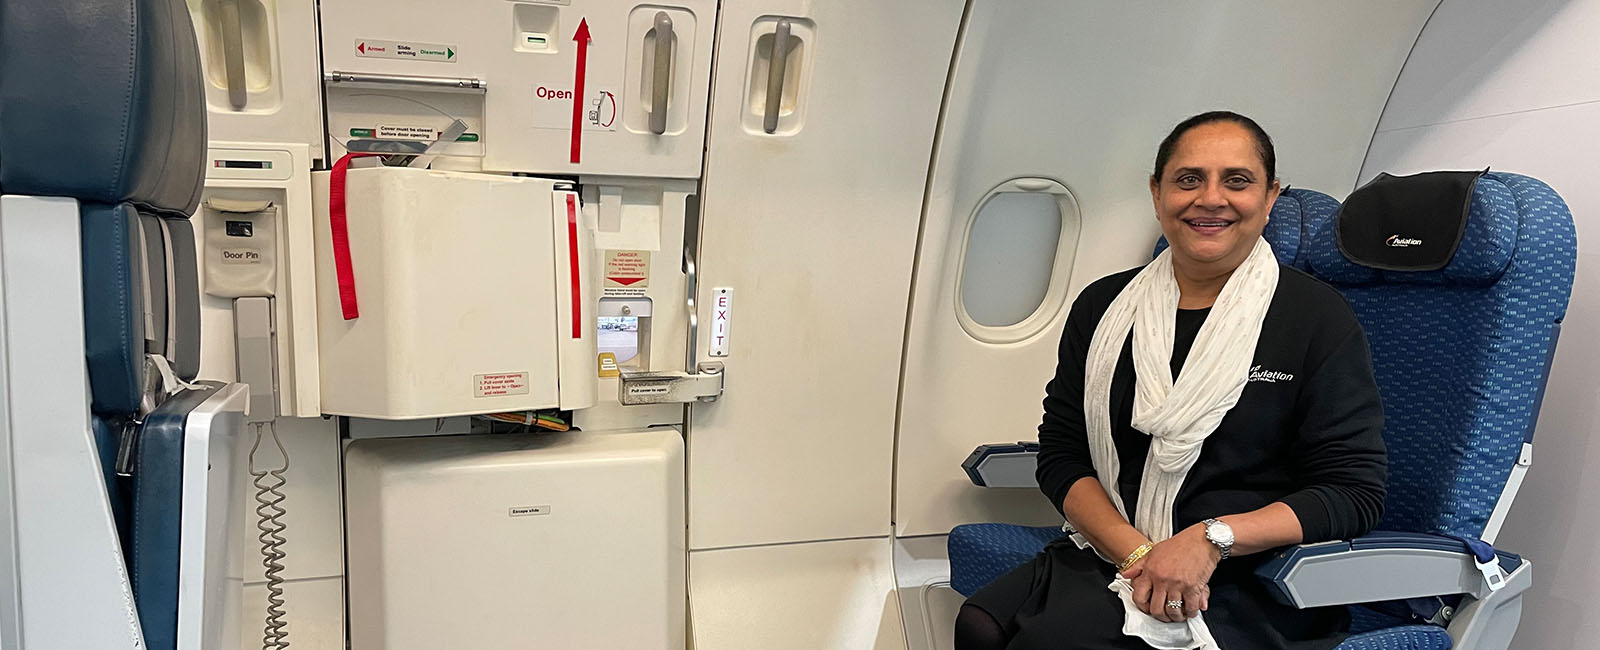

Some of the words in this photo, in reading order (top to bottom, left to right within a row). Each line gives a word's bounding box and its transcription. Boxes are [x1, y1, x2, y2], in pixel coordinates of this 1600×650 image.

[536, 86, 573, 100] Open
[1393, 238, 1422, 246] Aviation
[223, 251, 243, 259] Door
[246, 251, 259, 259] Pin
[716, 296, 727, 346] EXIT
[1250, 370, 1294, 381] Aviation
